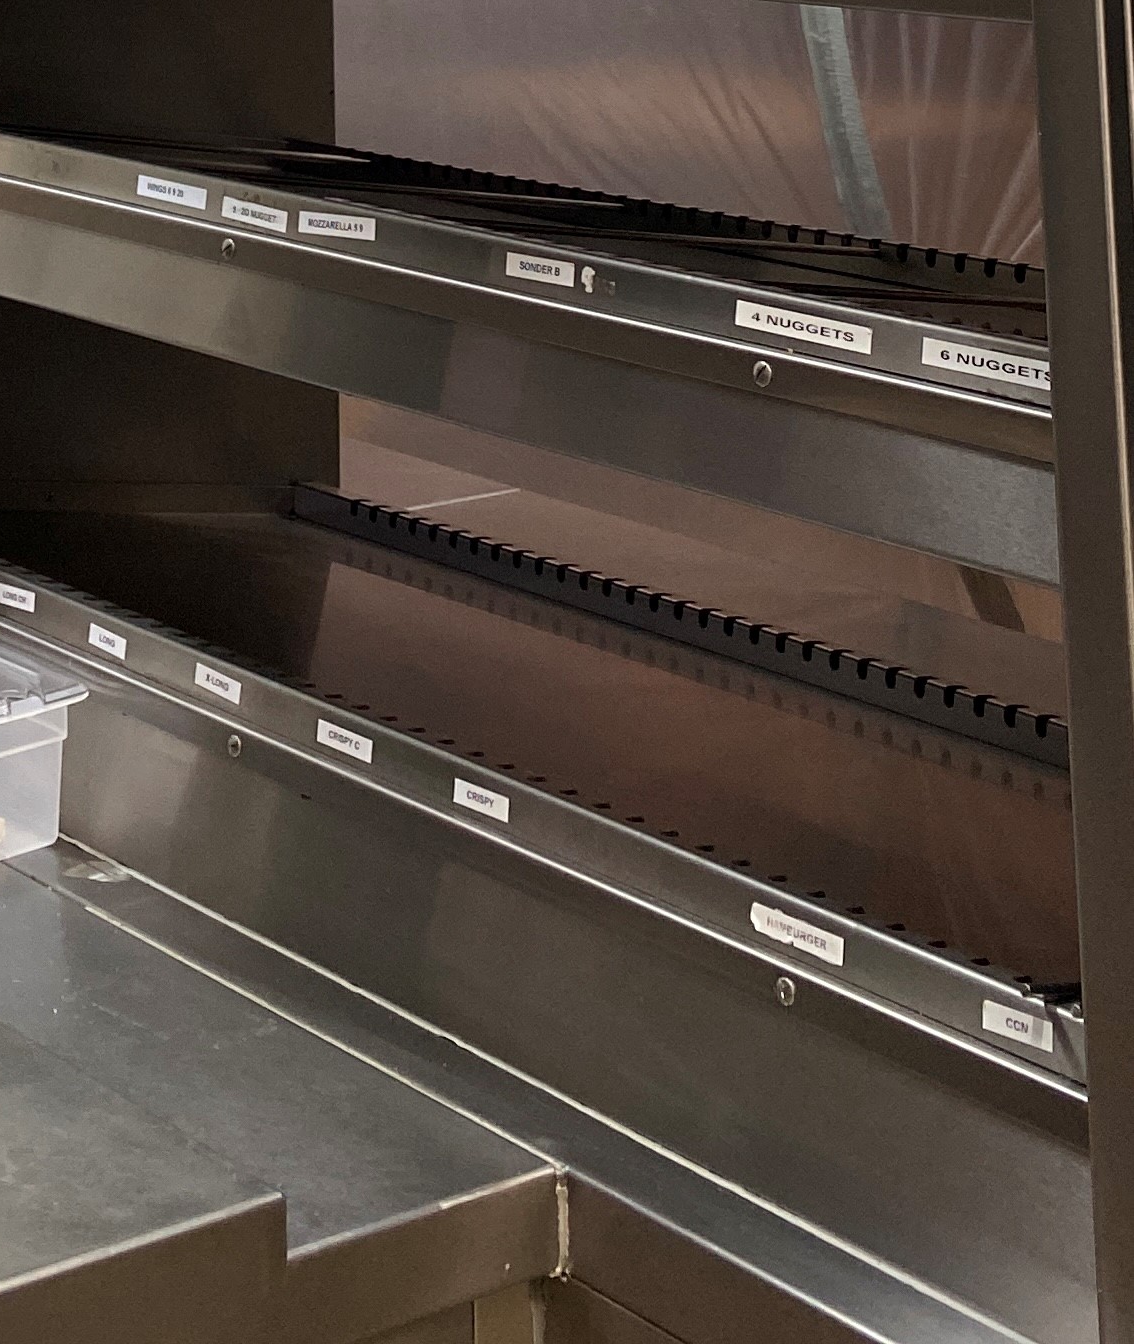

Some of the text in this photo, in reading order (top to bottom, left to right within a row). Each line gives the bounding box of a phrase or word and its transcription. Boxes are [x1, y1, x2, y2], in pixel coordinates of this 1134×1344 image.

[308, 218, 352, 231] MOZZARELLA
[519, 261, 561, 277] SONDER B
[751, 312, 854, 342] 4 NUGGETS
[940, 349, 950, 361] 6
[98, 633, 116, 648] LONG
[204, 673, 229, 692] X-LONG
[328, 729, 361, 751] CRISPY C
[466, 790, 495, 808] CRISPY
[1005, 1017, 1029, 1034] CCN
